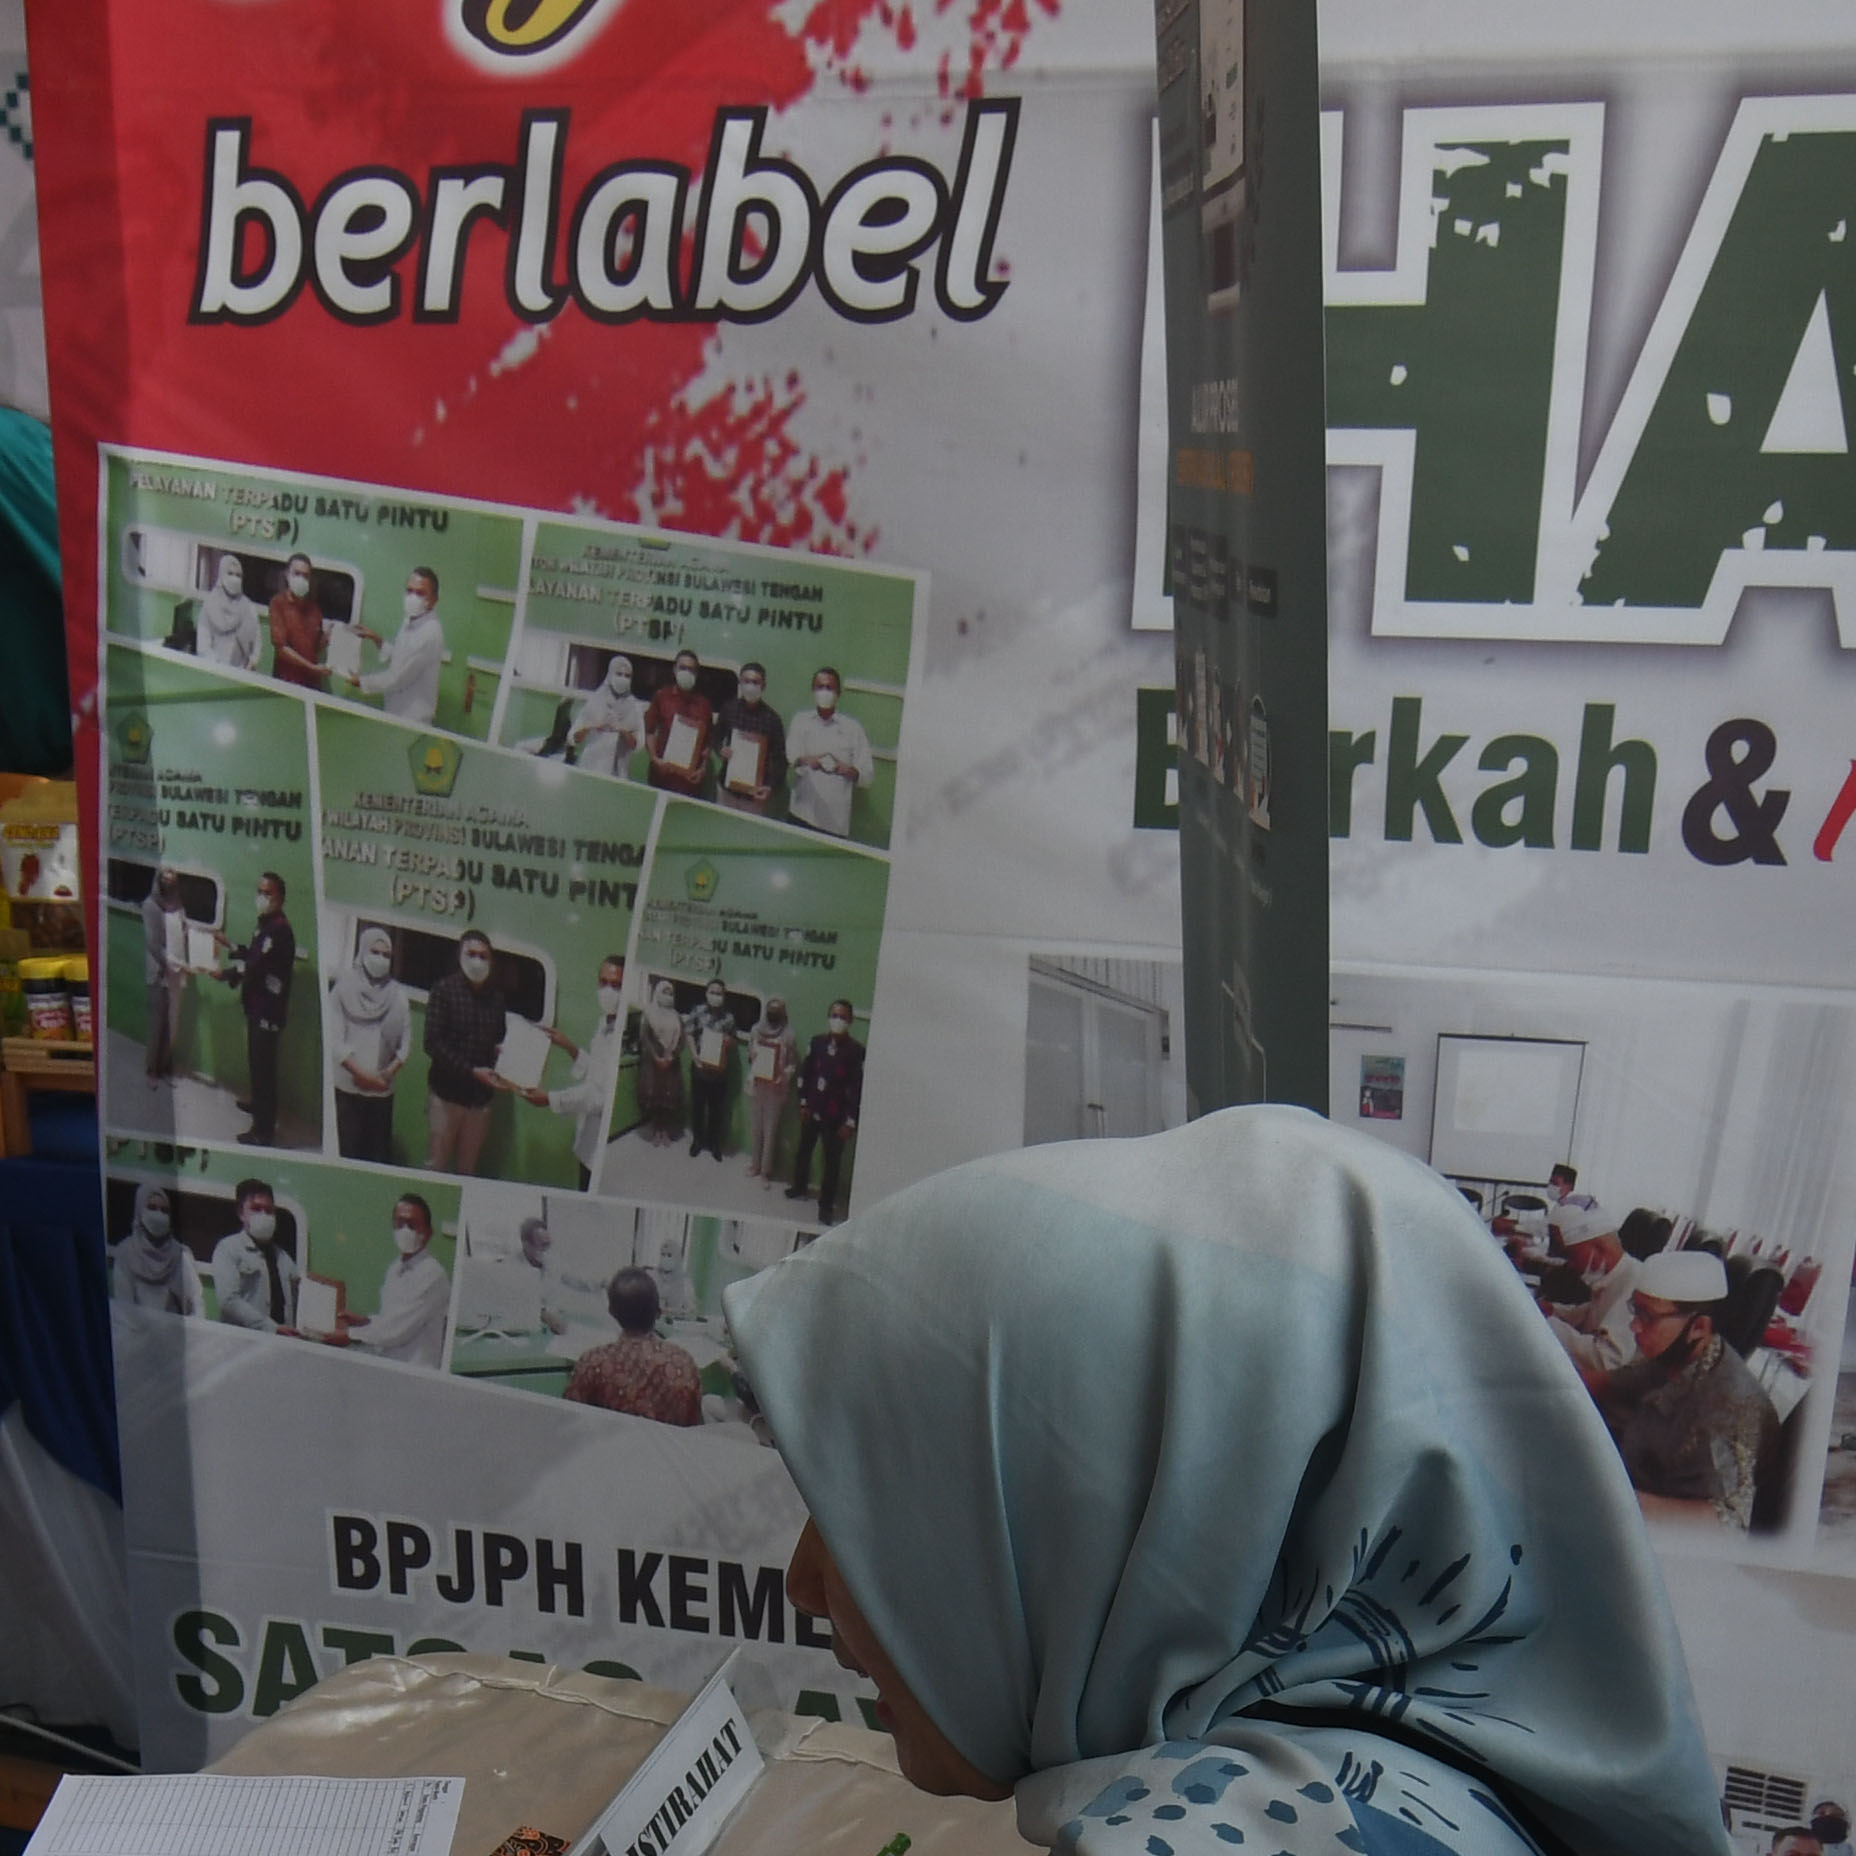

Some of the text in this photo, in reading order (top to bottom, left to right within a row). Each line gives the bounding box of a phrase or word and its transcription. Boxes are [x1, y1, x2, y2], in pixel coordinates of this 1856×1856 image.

[186, 97, 1021, 326] berlabel
[314, 499, 369, 525] SATU
[377, 509, 450, 532] PINTU
[699, 601, 750, 623] SATU
[758, 608, 823, 633] PINTU
[1681, 718, 1792, 868] &
[177, 811, 302, 841] SATU PINTU
[573, 840, 646, 867] TENGA
[385, 850, 639, 910] TERPADU SATU PINT
[393, 876, 476, 921] (PTSP)
[779, 949, 835, 970] PINTU
[332, 1515, 834, 1650] BPJPH KEME
